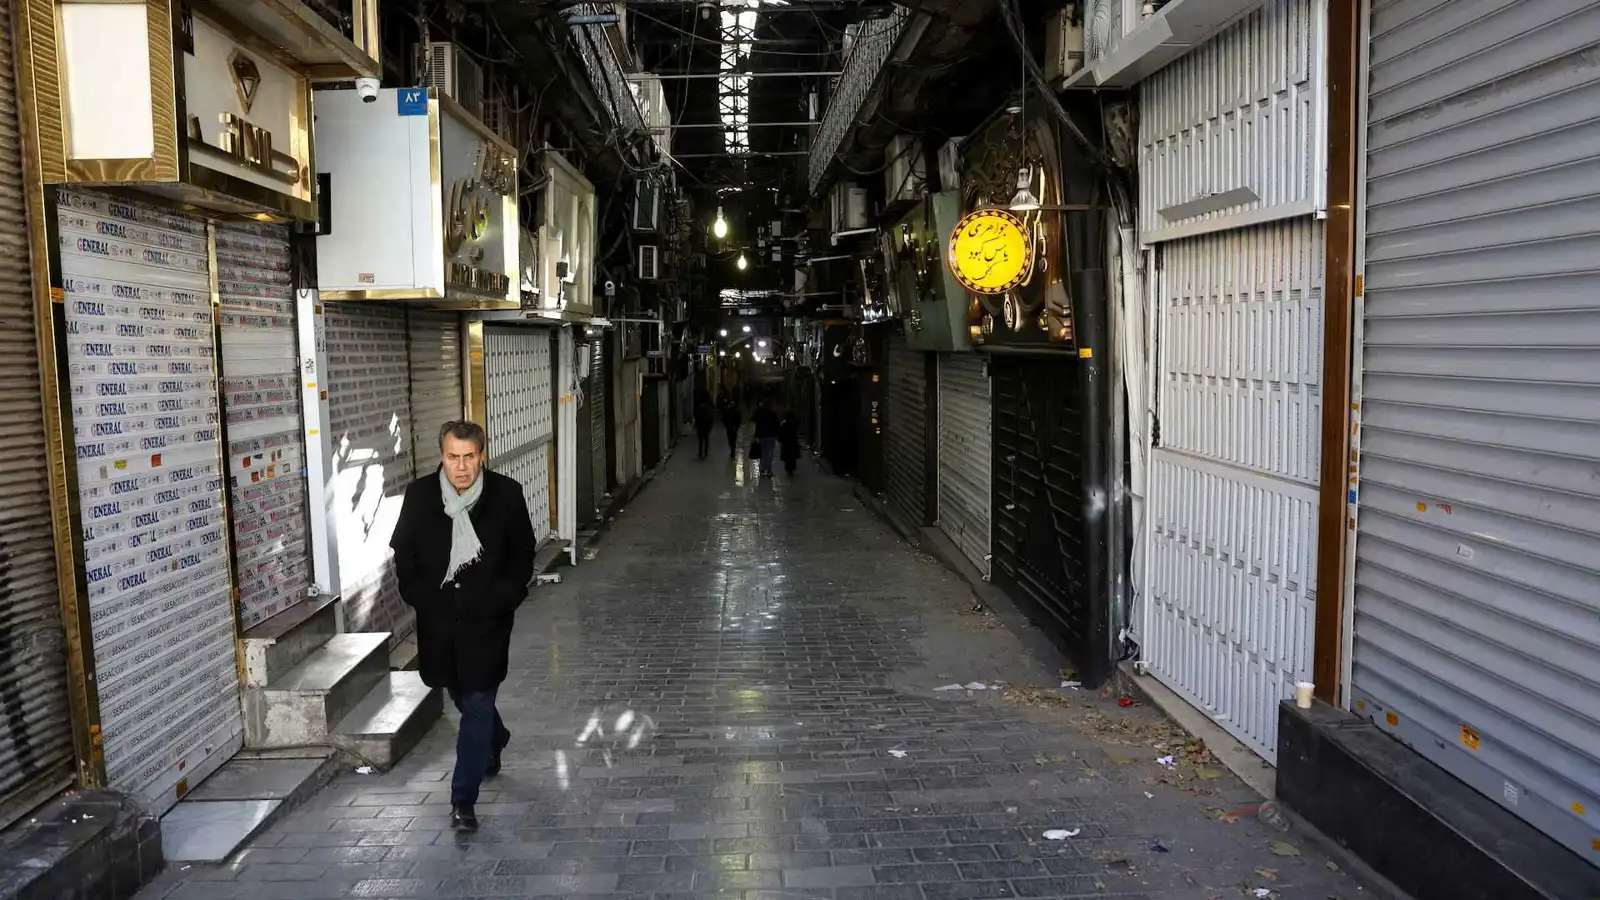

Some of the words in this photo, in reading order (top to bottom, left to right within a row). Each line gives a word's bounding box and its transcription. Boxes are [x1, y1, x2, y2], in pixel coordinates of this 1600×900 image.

[405, 91, 421, 103] ۸۳
[108, 203, 138, 221] GENERAL
[95, 220, 128, 239] GENERAL
[76, 236, 110, 256] GENERAL
[142, 250, 170, 265] GENERAL
[111, 284, 142, 300] GENERAL
[72, 300, 106, 316] GENERAL
[138, 307, 166, 321] GENERAL
[115, 323, 145, 338] GENERAL
[173, 327, 199, 341] GENERAL
[80, 343, 114, 357] GENERAL
[145, 345, 173, 357] GENERAL
[107, 362, 138, 375] GENERAL
[167, 362, 193, 374] GENERAL
[95, 382, 127, 396] GENERAL
[157, 380, 184, 393] GENERAL
[94, 401, 127, 417] GENERAL
[157, 398, 184, 412] GENERAL
[90, 421, 123, 436] GENERAL
[153, 415, 180, 430] GENERAL
[139, 435, 167, 450] GENERAL
[108, 478, 139, 495] GENERAL
[168, 467, 193, 483] GENERAL
[87, 500, 122, 519] GENERAL
[153, 488, 181, 505] GENERAL
[130, 510, 160, 529] GENERAL
[187, 498, 212, 514] GENERAL
[185, 514, 209, 532] GENERAL
[145, 545, 173, 563] GENERAL
[200, 528, 222, 546] GENERAL
[116, 571, 148, 591] GENERAL
